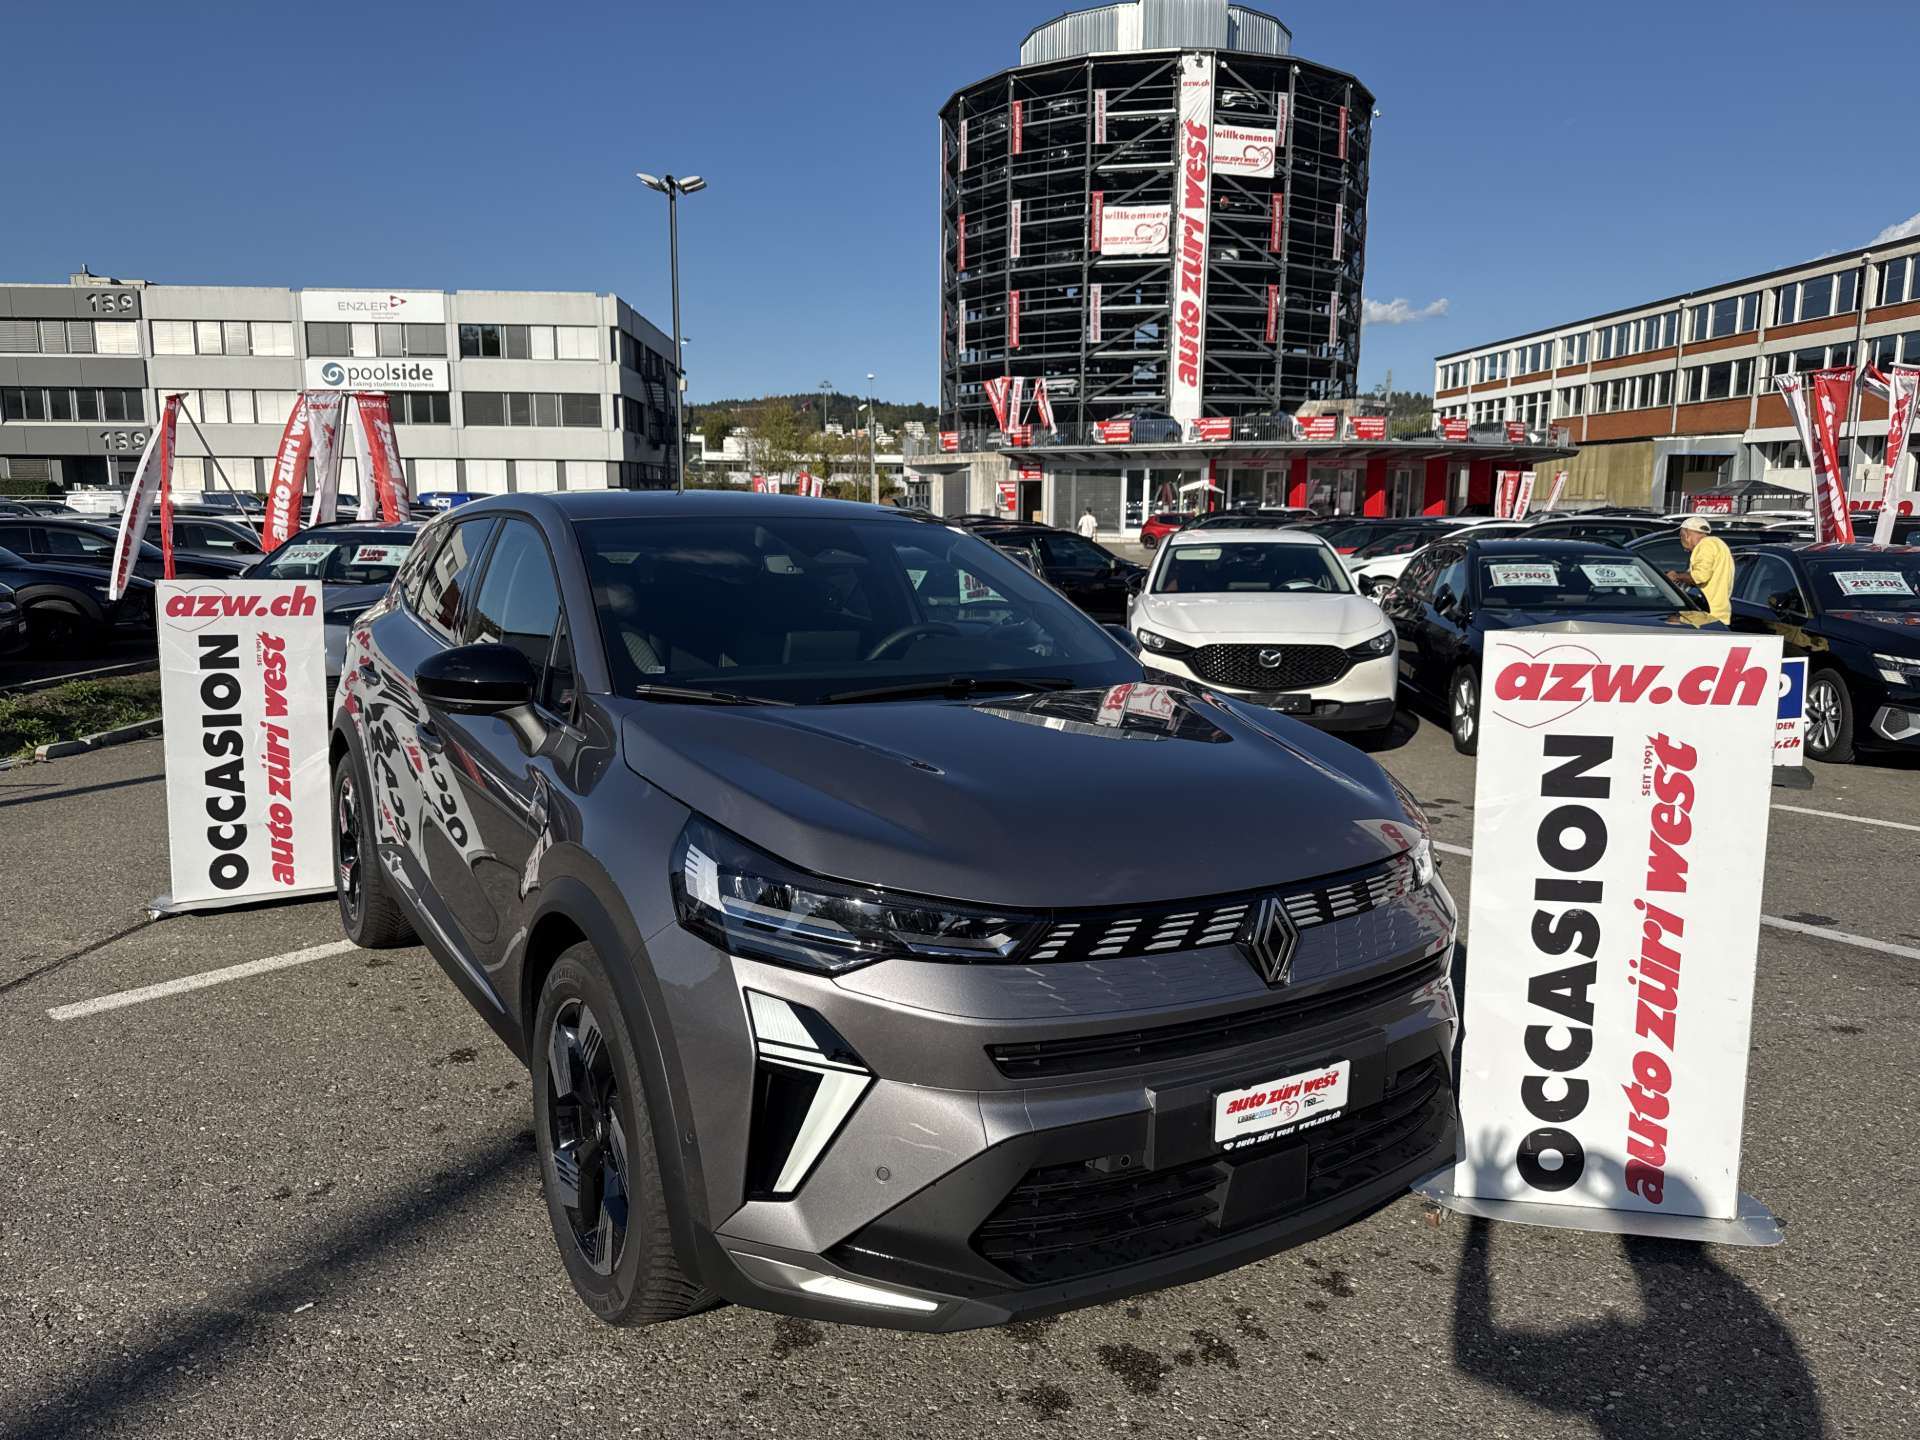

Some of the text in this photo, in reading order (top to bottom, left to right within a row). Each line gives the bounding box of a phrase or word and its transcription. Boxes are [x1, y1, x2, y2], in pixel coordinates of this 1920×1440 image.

[1183, 79, 1210, 87] azw.ch
[1214, 129, 1274, 143] willkommen
[1104, 210, 1169, 220] willkommen
[1176, 118, 1208, 388] auto züri west
[86, 293, 133, 313] 139
[338, 301, 388, 311] ENZLER
[347, 363, 433, 387] poolside
[100, 431, 146, 450] 139
[277, 437, 301, 485] züri
[273, 484, 292, 542] auto
[1502, 571, 1552, 580] 23'800
[165, 585, 317, 618] azw.ch
[1494, 646, 1769, 708] azw.ch
[1775, 721, 1795, 730] DEN
[198, 634, 250, 891] OCCASION
[257, 631, 296, 887] auto züri west
[1641, 745, 1654, 797] SEIT 1991
[1515, 733, 1615, 1193] OCCASION
[1618, 731, 1699, 1205] auto züri west
[1226, 1092, 1267, 1115] auto
[1266, 1078, 1304, 1105] züri
[1303, 1070, 1340, 1094] west
[1235, 1110, 1342, 1149] auto züri west www.azw.ch
